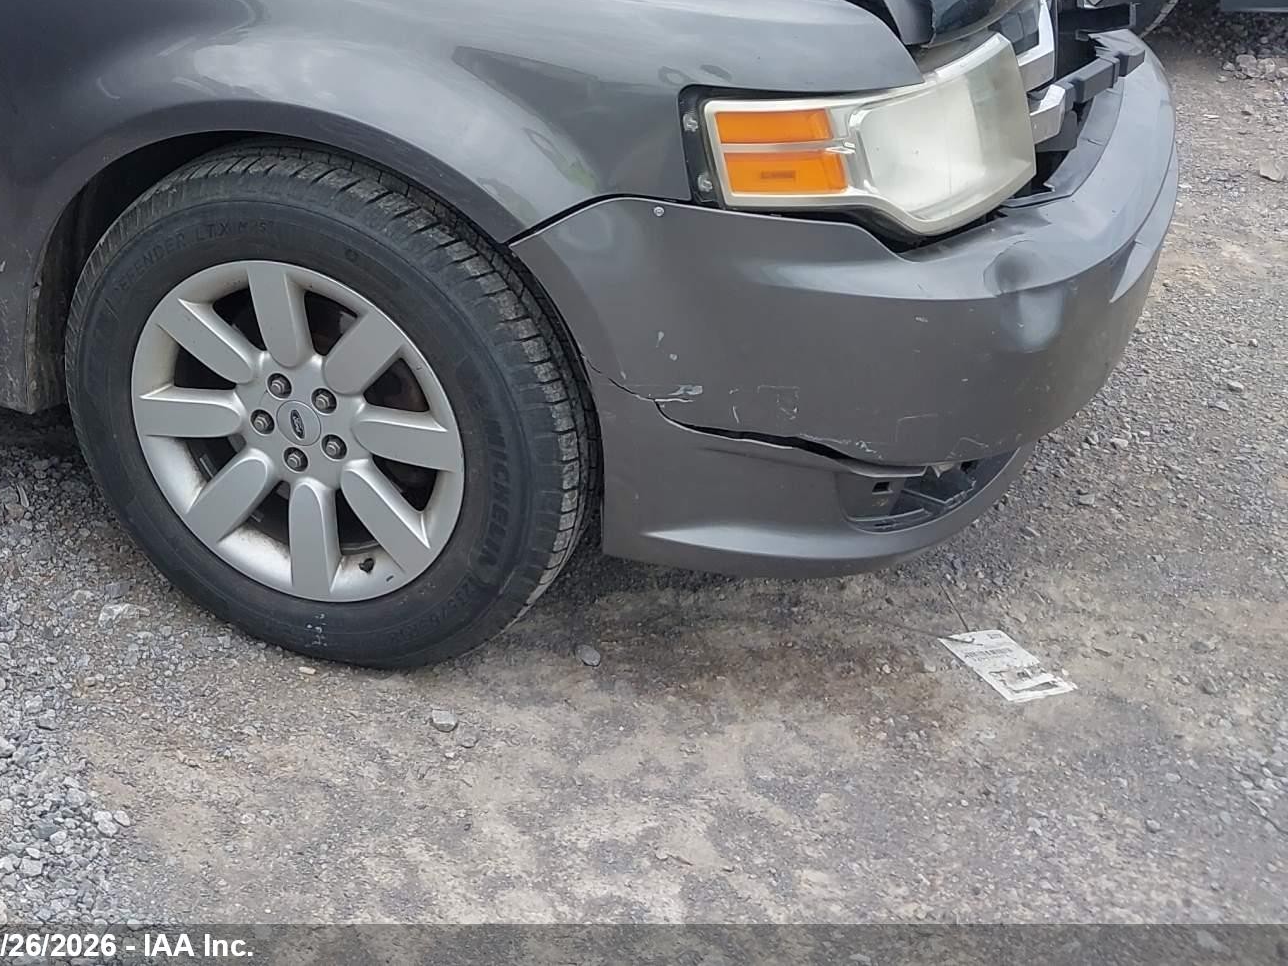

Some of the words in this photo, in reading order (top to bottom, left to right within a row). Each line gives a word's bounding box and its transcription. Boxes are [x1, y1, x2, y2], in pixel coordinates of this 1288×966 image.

[113, 232, 189, 293] EFENDER
[196, 221, 232, 242] LTX
[477, 419, 512, 566] MICHELIN
